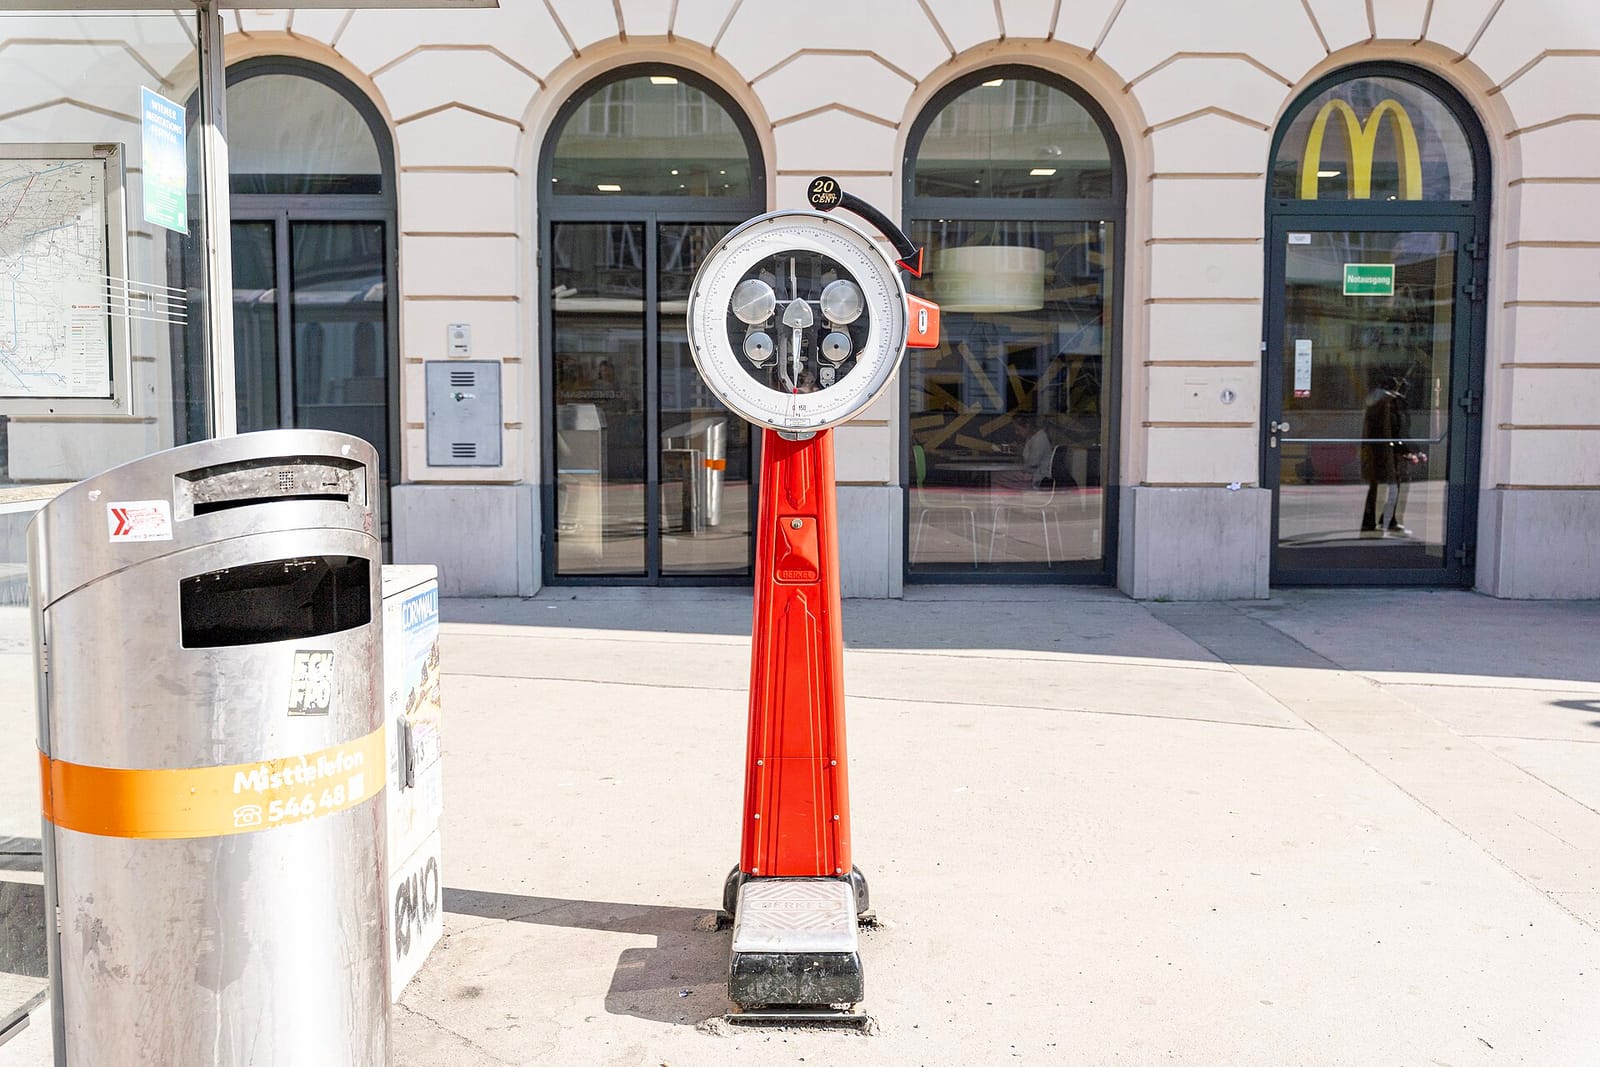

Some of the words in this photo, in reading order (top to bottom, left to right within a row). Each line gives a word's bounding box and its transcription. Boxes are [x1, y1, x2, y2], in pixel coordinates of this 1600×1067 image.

[813, 180, 835, 193] 20
[811, 193, 838, 204] CENT
[1347, 274, 1391, 286] Notausgang
[402, 589, 438, 628] CORNWALL
[267, 793, 316, 822] 546
[319, 783, 345, 809] 48
